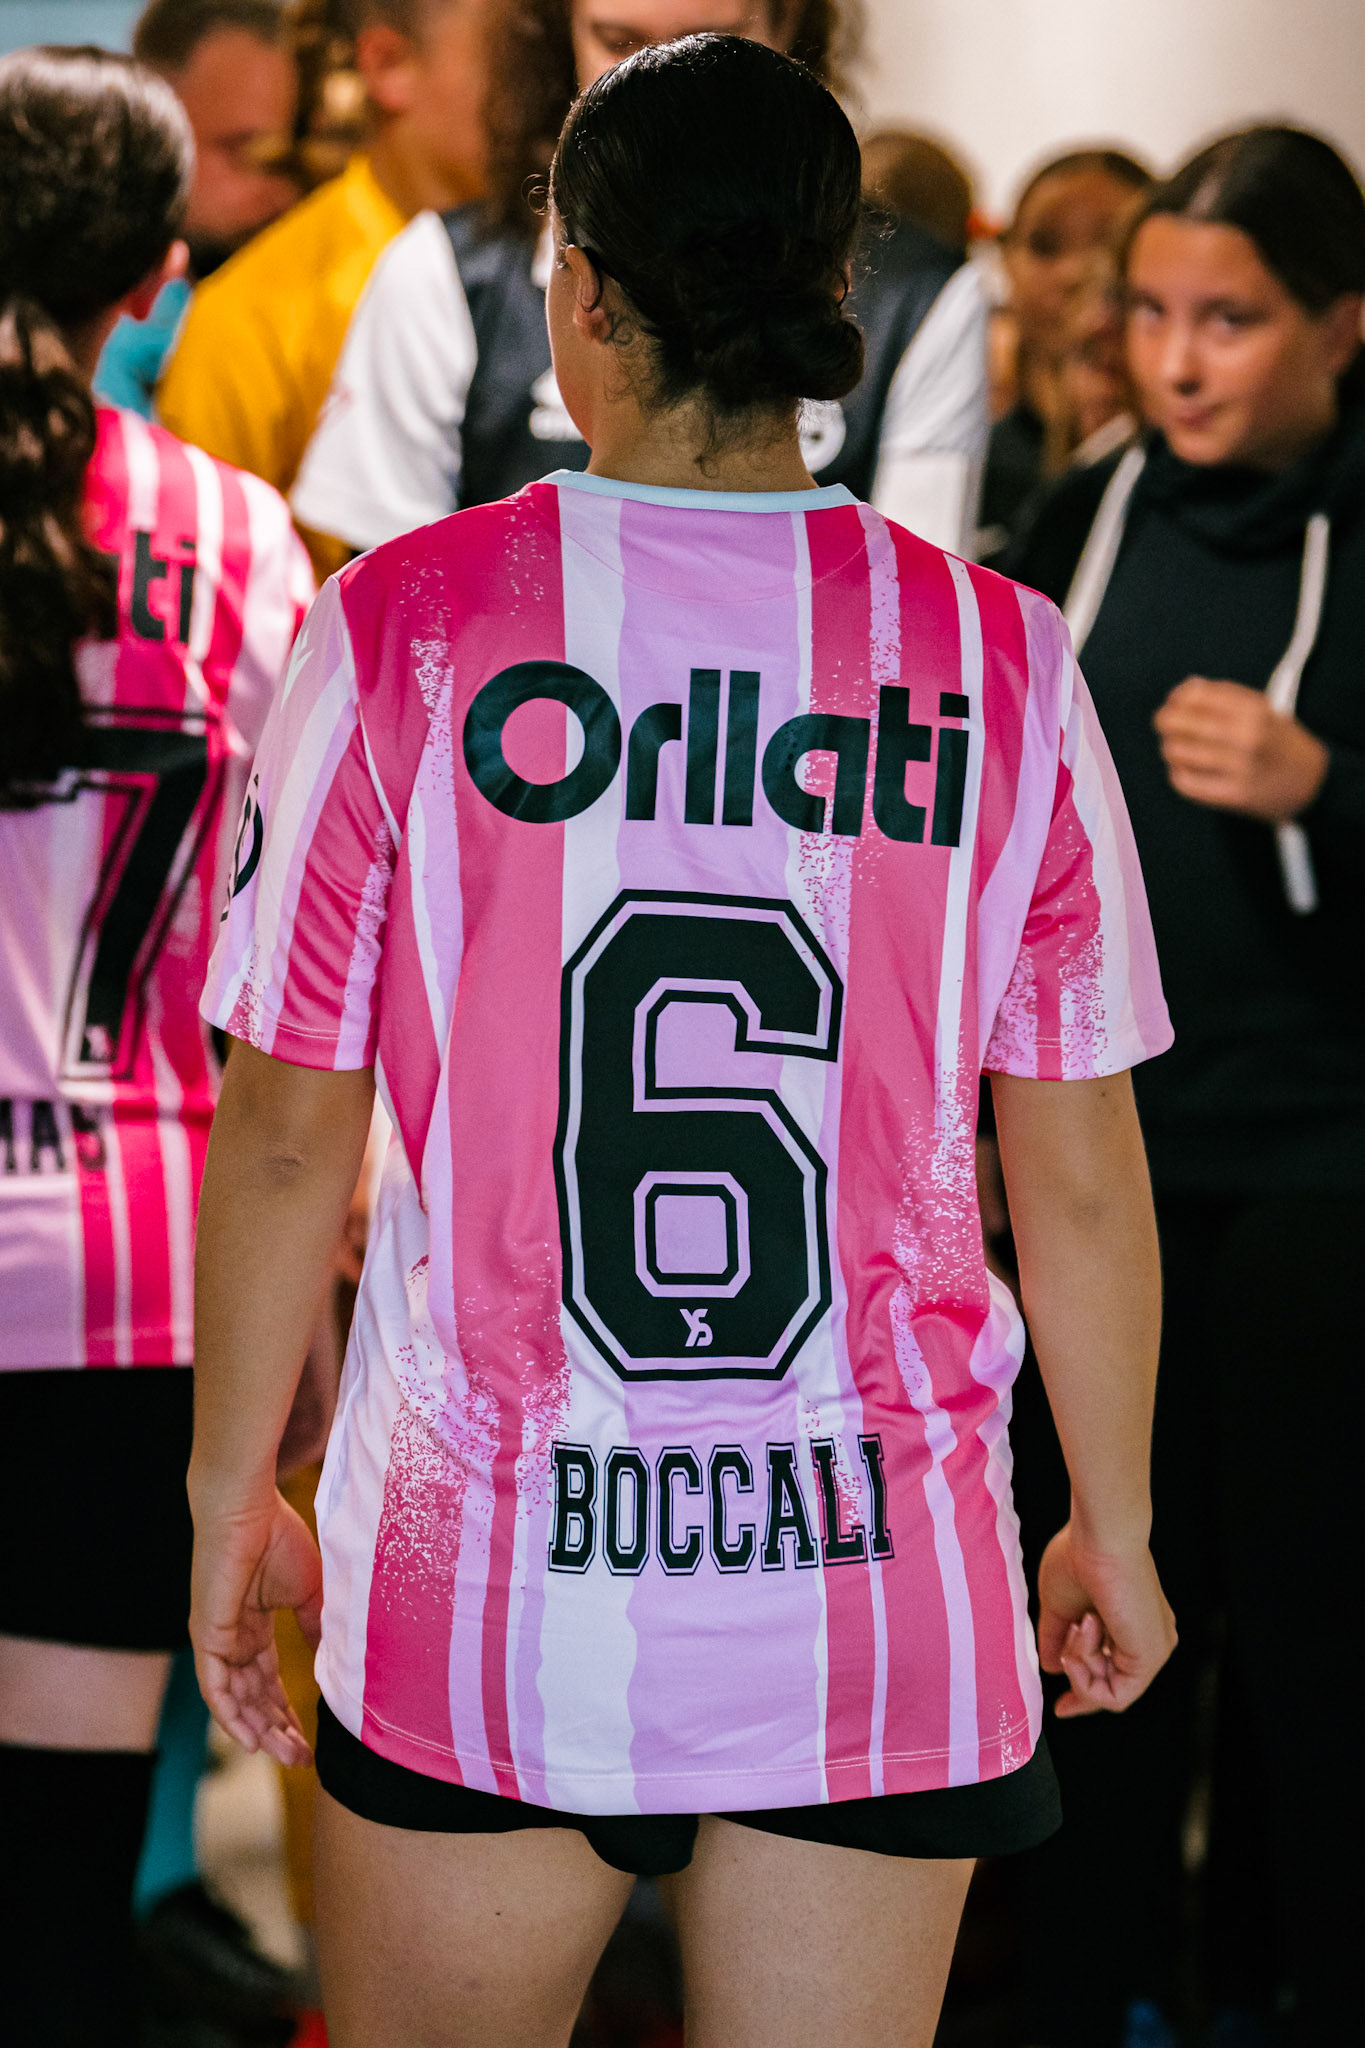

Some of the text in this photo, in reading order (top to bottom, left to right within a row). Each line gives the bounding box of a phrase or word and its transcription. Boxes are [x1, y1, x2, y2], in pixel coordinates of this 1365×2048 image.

[462, 660, 970, 848] Orllati
[553, 888, 844, 1381] 6
[548, 1433, 895, 1576] BOCCALI
